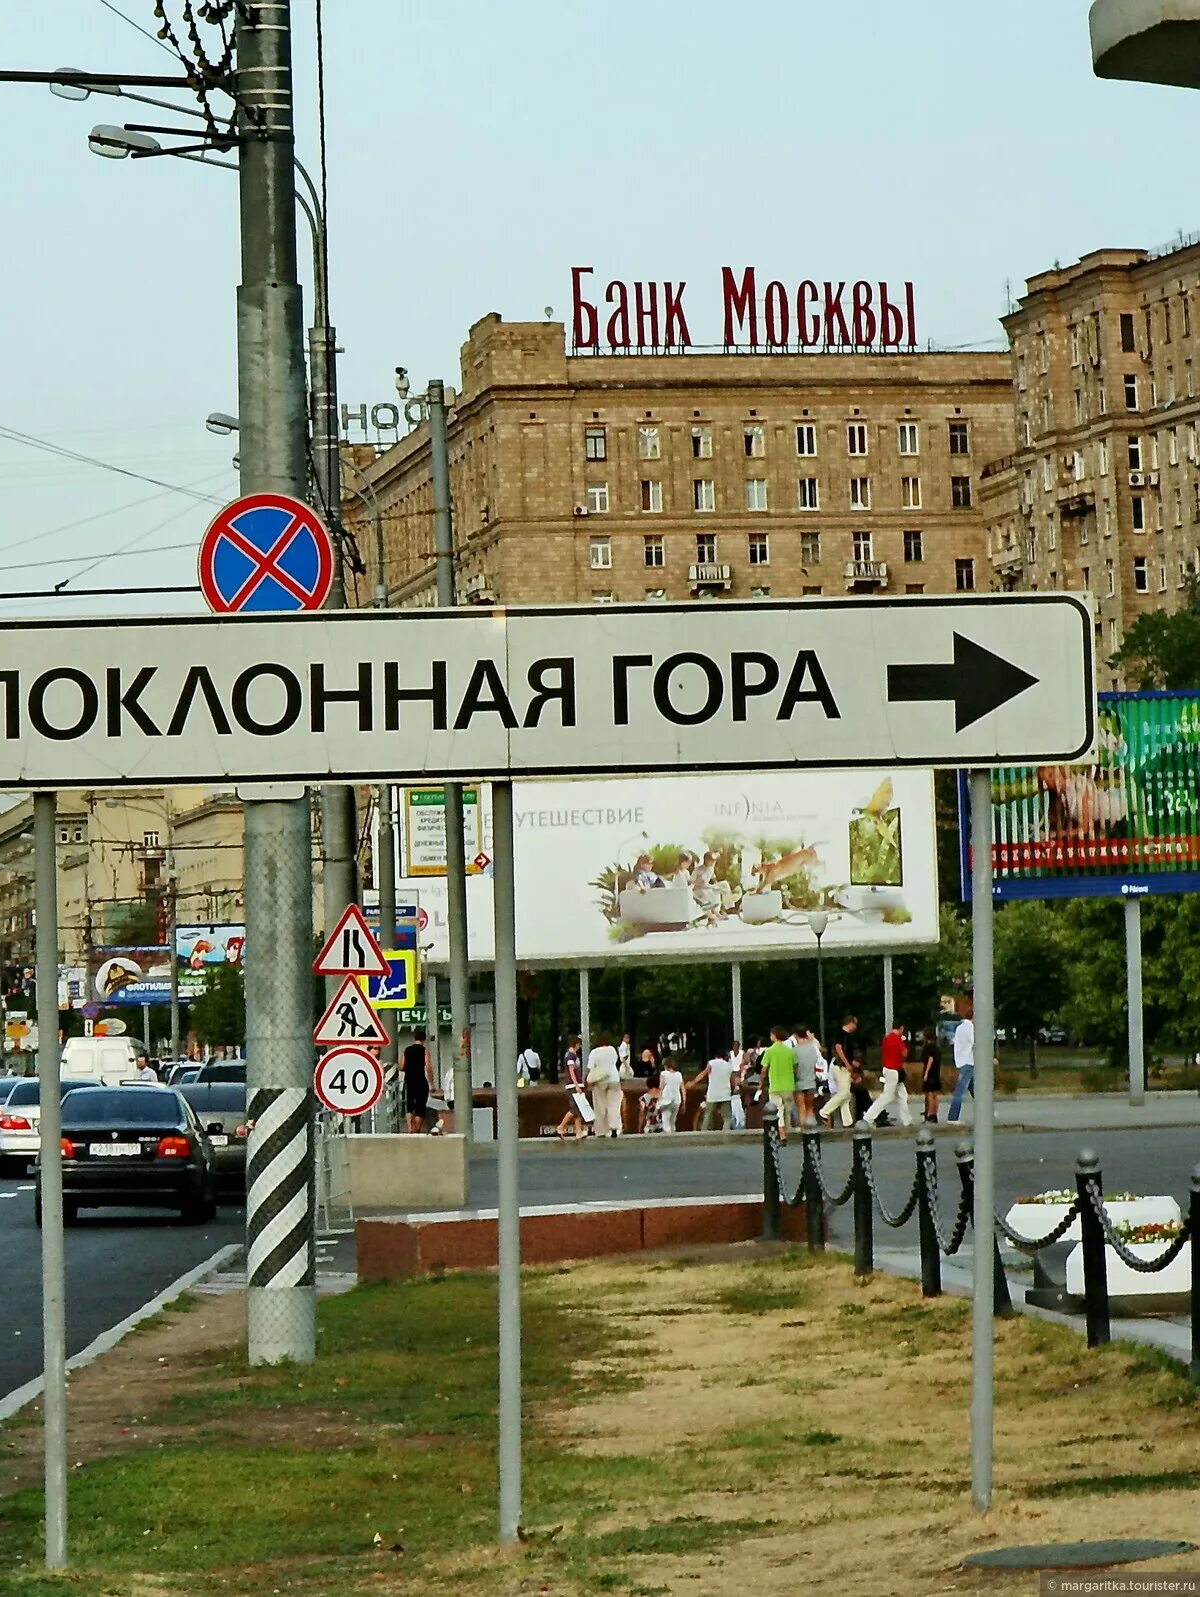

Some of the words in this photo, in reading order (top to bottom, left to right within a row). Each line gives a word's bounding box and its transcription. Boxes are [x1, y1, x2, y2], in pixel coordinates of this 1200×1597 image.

[572, 267, 691, 348] Банк
[722, 267, 917, 348] Москвы
[612, 649, 842, 726] ГОРА
[515, 806, 645, 828] УТЕШЕСТВИЕ
[328, 1069, 369, 1095] 40
